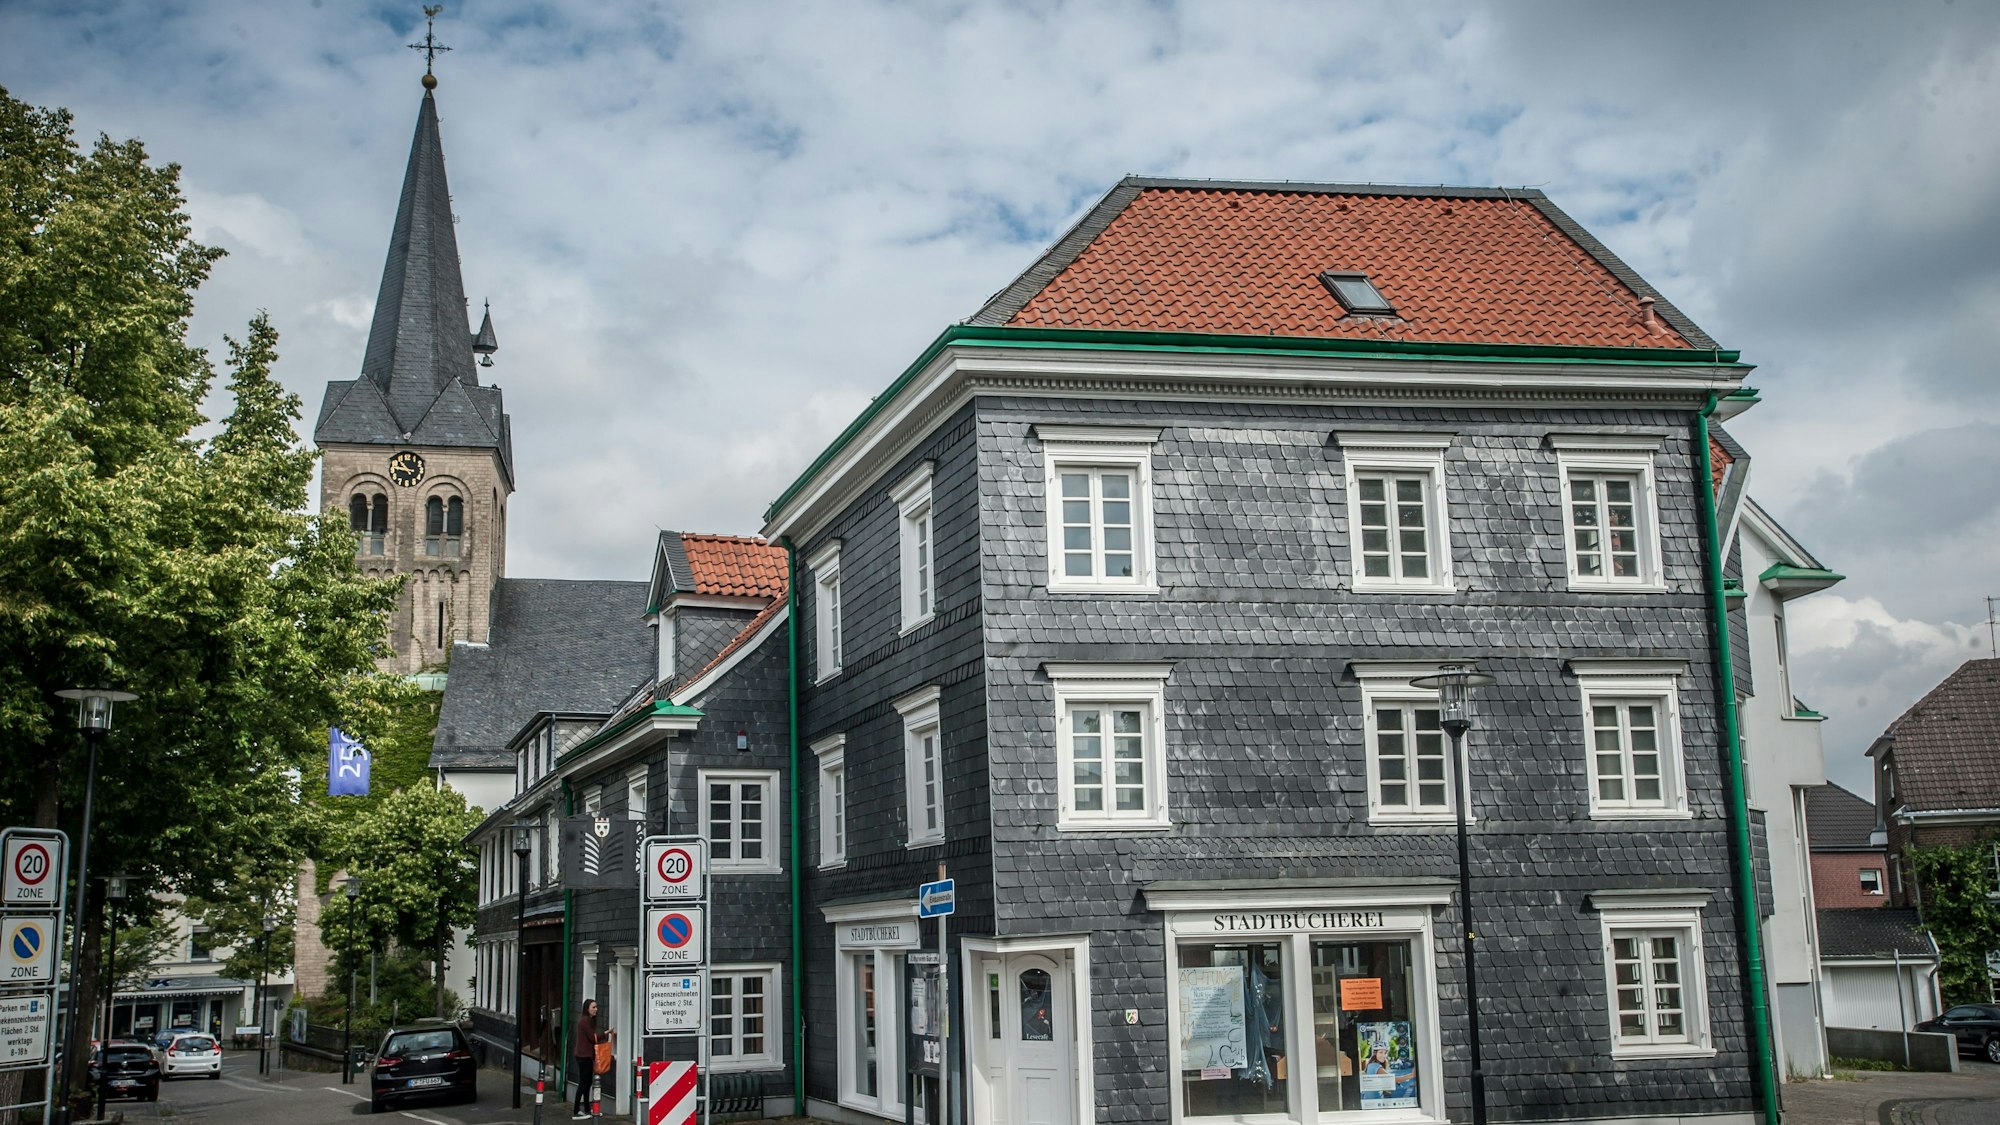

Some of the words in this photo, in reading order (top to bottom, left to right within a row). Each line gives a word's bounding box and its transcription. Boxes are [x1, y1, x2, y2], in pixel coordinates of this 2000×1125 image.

[22, 855, 42, 873] 20
[666, 858, 685, 874] 20
[17, 888, 44, 898] ZONE
[662, 885, 688, 894] ZONE
[1214, 911, 1384, 930] STADTBÜCHEREI
[662, 951, 688, 960] ZONE
[11, 966, 39, 978] ZONE
[651, 990, 698, 999] gekennzeichneten
[0, 1014, 45, 1024] ekennzeichneten
[1, 1026, 22, 1035] Flächen
[8, 1038, 32, 1046] werktags
